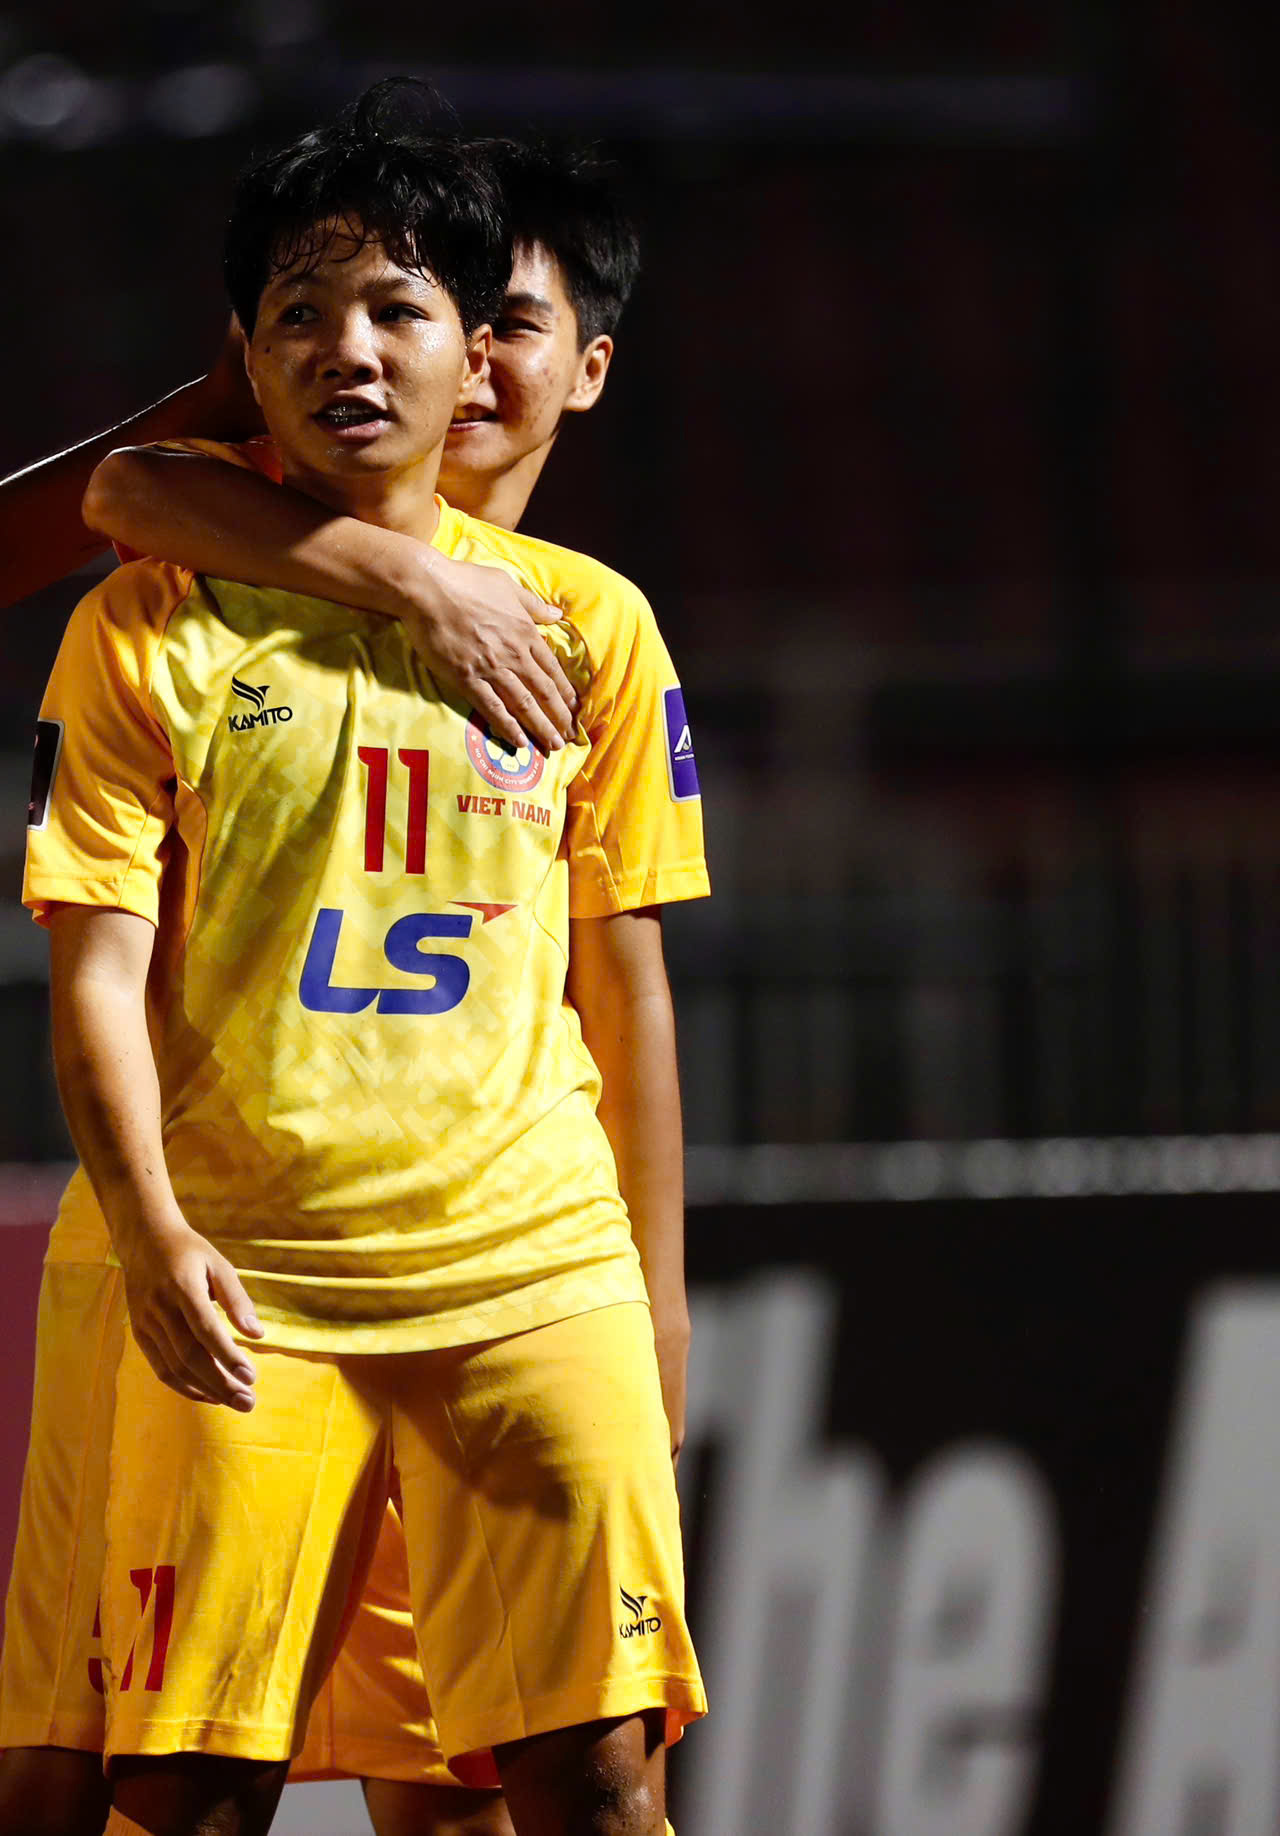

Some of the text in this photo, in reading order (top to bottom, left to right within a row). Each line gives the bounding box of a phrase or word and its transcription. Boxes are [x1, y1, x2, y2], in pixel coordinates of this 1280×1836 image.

[228, 706, 293, 733] KAMITO
[357, 746, 429, 875] 11
[457, 794, 552, 827] VIET NAM
[299, 908, 472, 1015] LS
